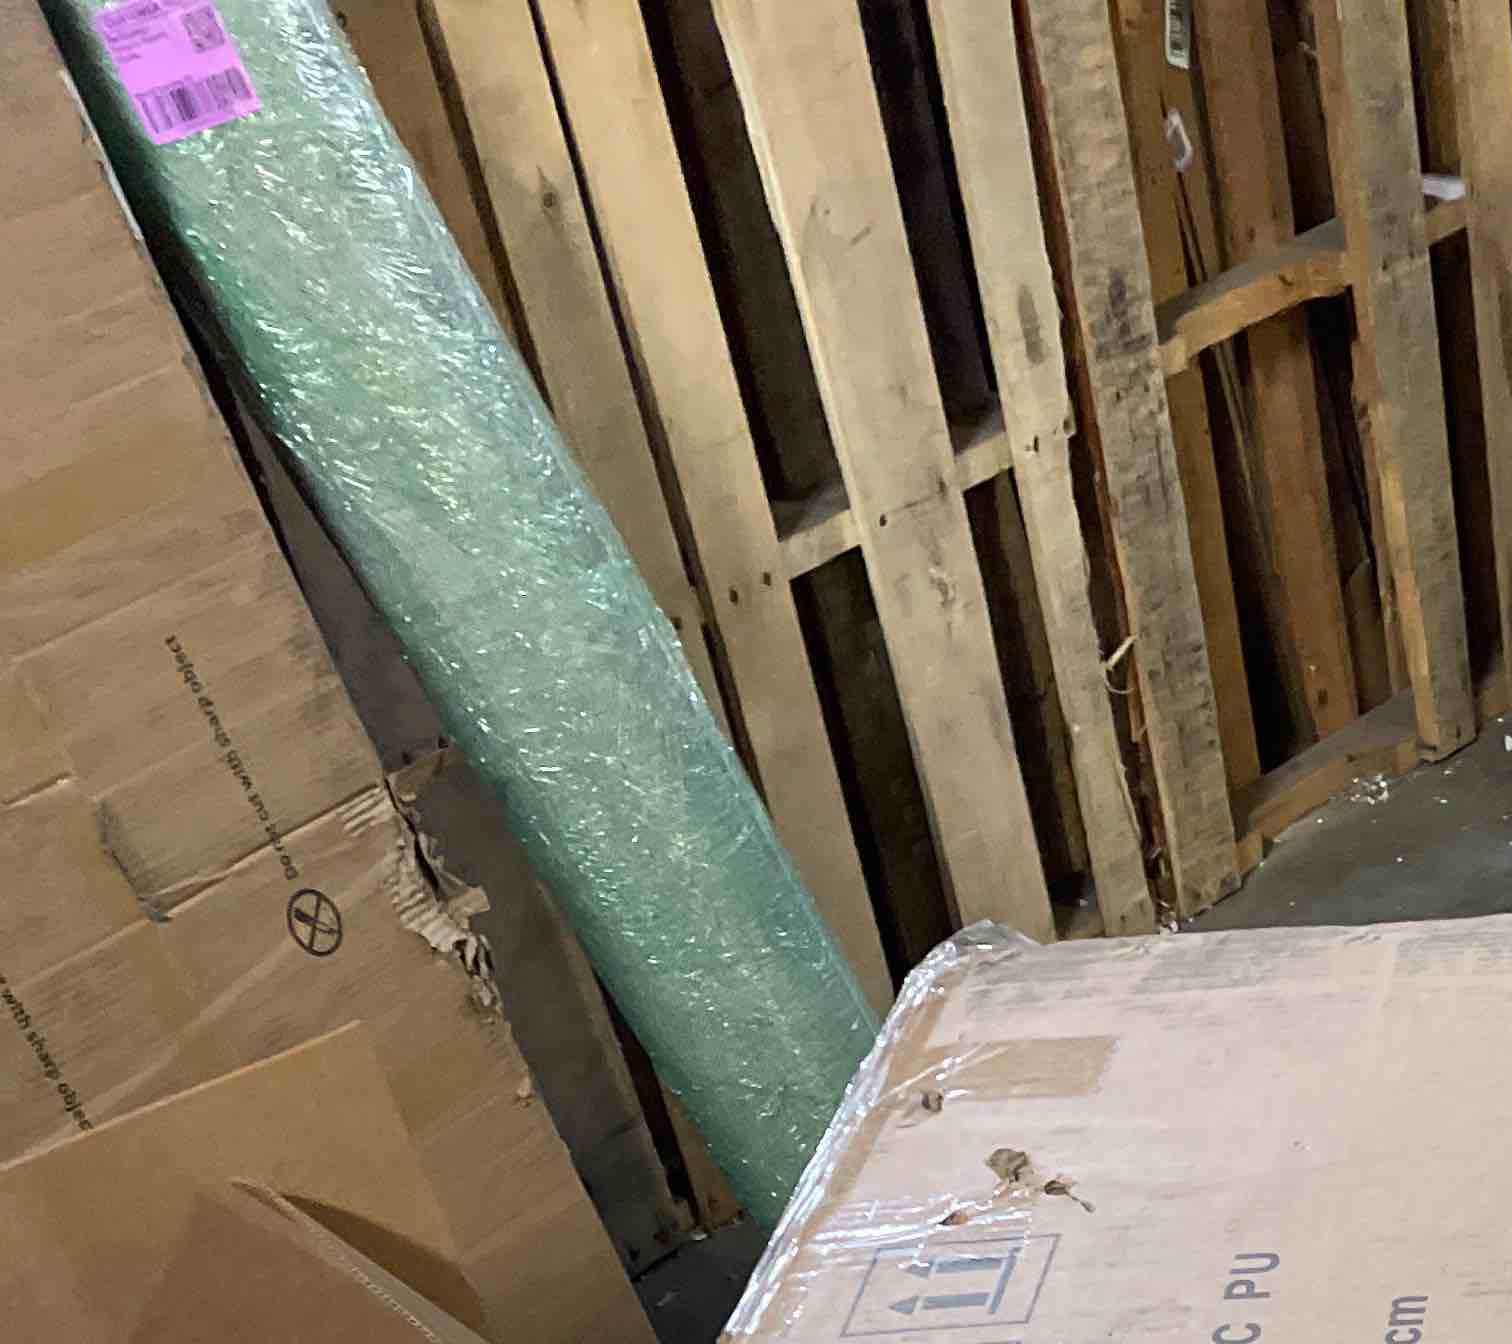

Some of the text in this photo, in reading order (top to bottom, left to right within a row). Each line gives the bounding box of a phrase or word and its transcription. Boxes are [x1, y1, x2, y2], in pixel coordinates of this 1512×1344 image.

[165, 634, 203, 694] object
[198, 696, 232, 748] sharp
[226, 749, 253, 791] with
[248, 793, 269, 821] cut
[1223, 1252, 1280, 1302] PU
